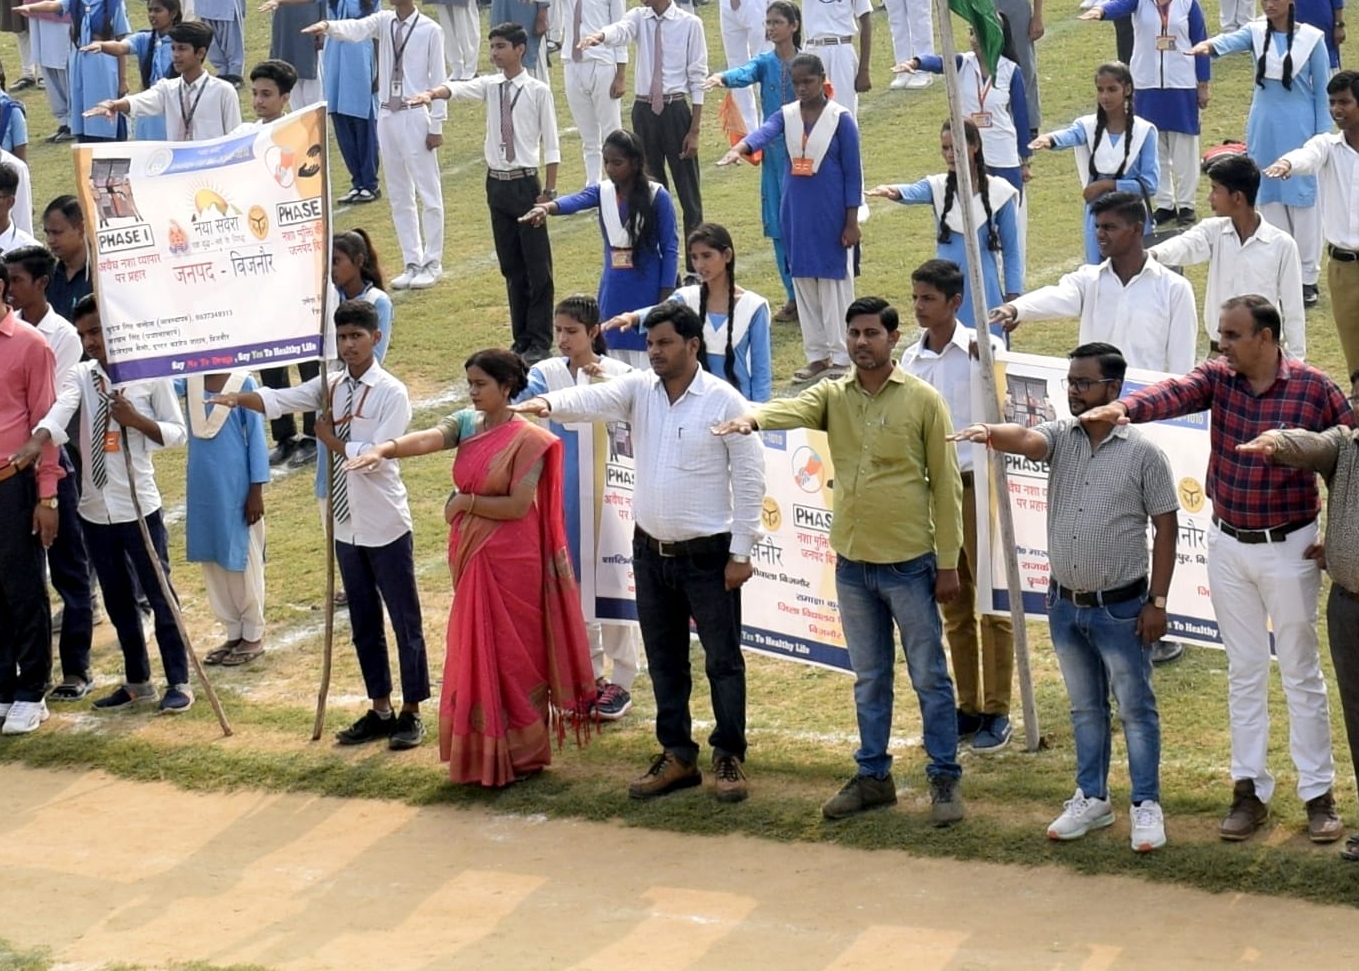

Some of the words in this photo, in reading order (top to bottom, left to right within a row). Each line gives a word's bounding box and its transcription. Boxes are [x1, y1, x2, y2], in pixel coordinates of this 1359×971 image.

[278, 200, 321, 223] PHASE
[192, 220, 213, 237] नया
[99, 232, 141, 250] PHASE
[144, 230, 149, 241] I
[173, 262, 217, 285] जनपद
[230, 246, 276, 278] बिजनौर
[115, 272, 126, 284] पर
[171, 360, 185, 371] Say
[273, 345, 301, 356] Healthy
[301, 342, 316, 352] Life
[1005, 454, 1050, 474] PHASE
[608, 468, 635, 485] PHA
[1007, 480, 1021, 495] वैध
[1023, 485, 1040, 496] नशा
[604, 492, 624, 506] अवैध
[1016, 498, 1027, 509] पर
[618, 510, 629, 521] पर
[796, 508, 832, 529] PHAS
[797, 532, 812, 545] नशा
[751, 536, 783, 567] जनौर
[801, 548, 824, 562] जनपद
[1173, 621, 1185, 631] To
[1185, 623, 1219, 638] Healthy
[755, 633, 764, 643] To
[765, 636, 794, 653] Healthy
[795, 643, 810, 654] Life
